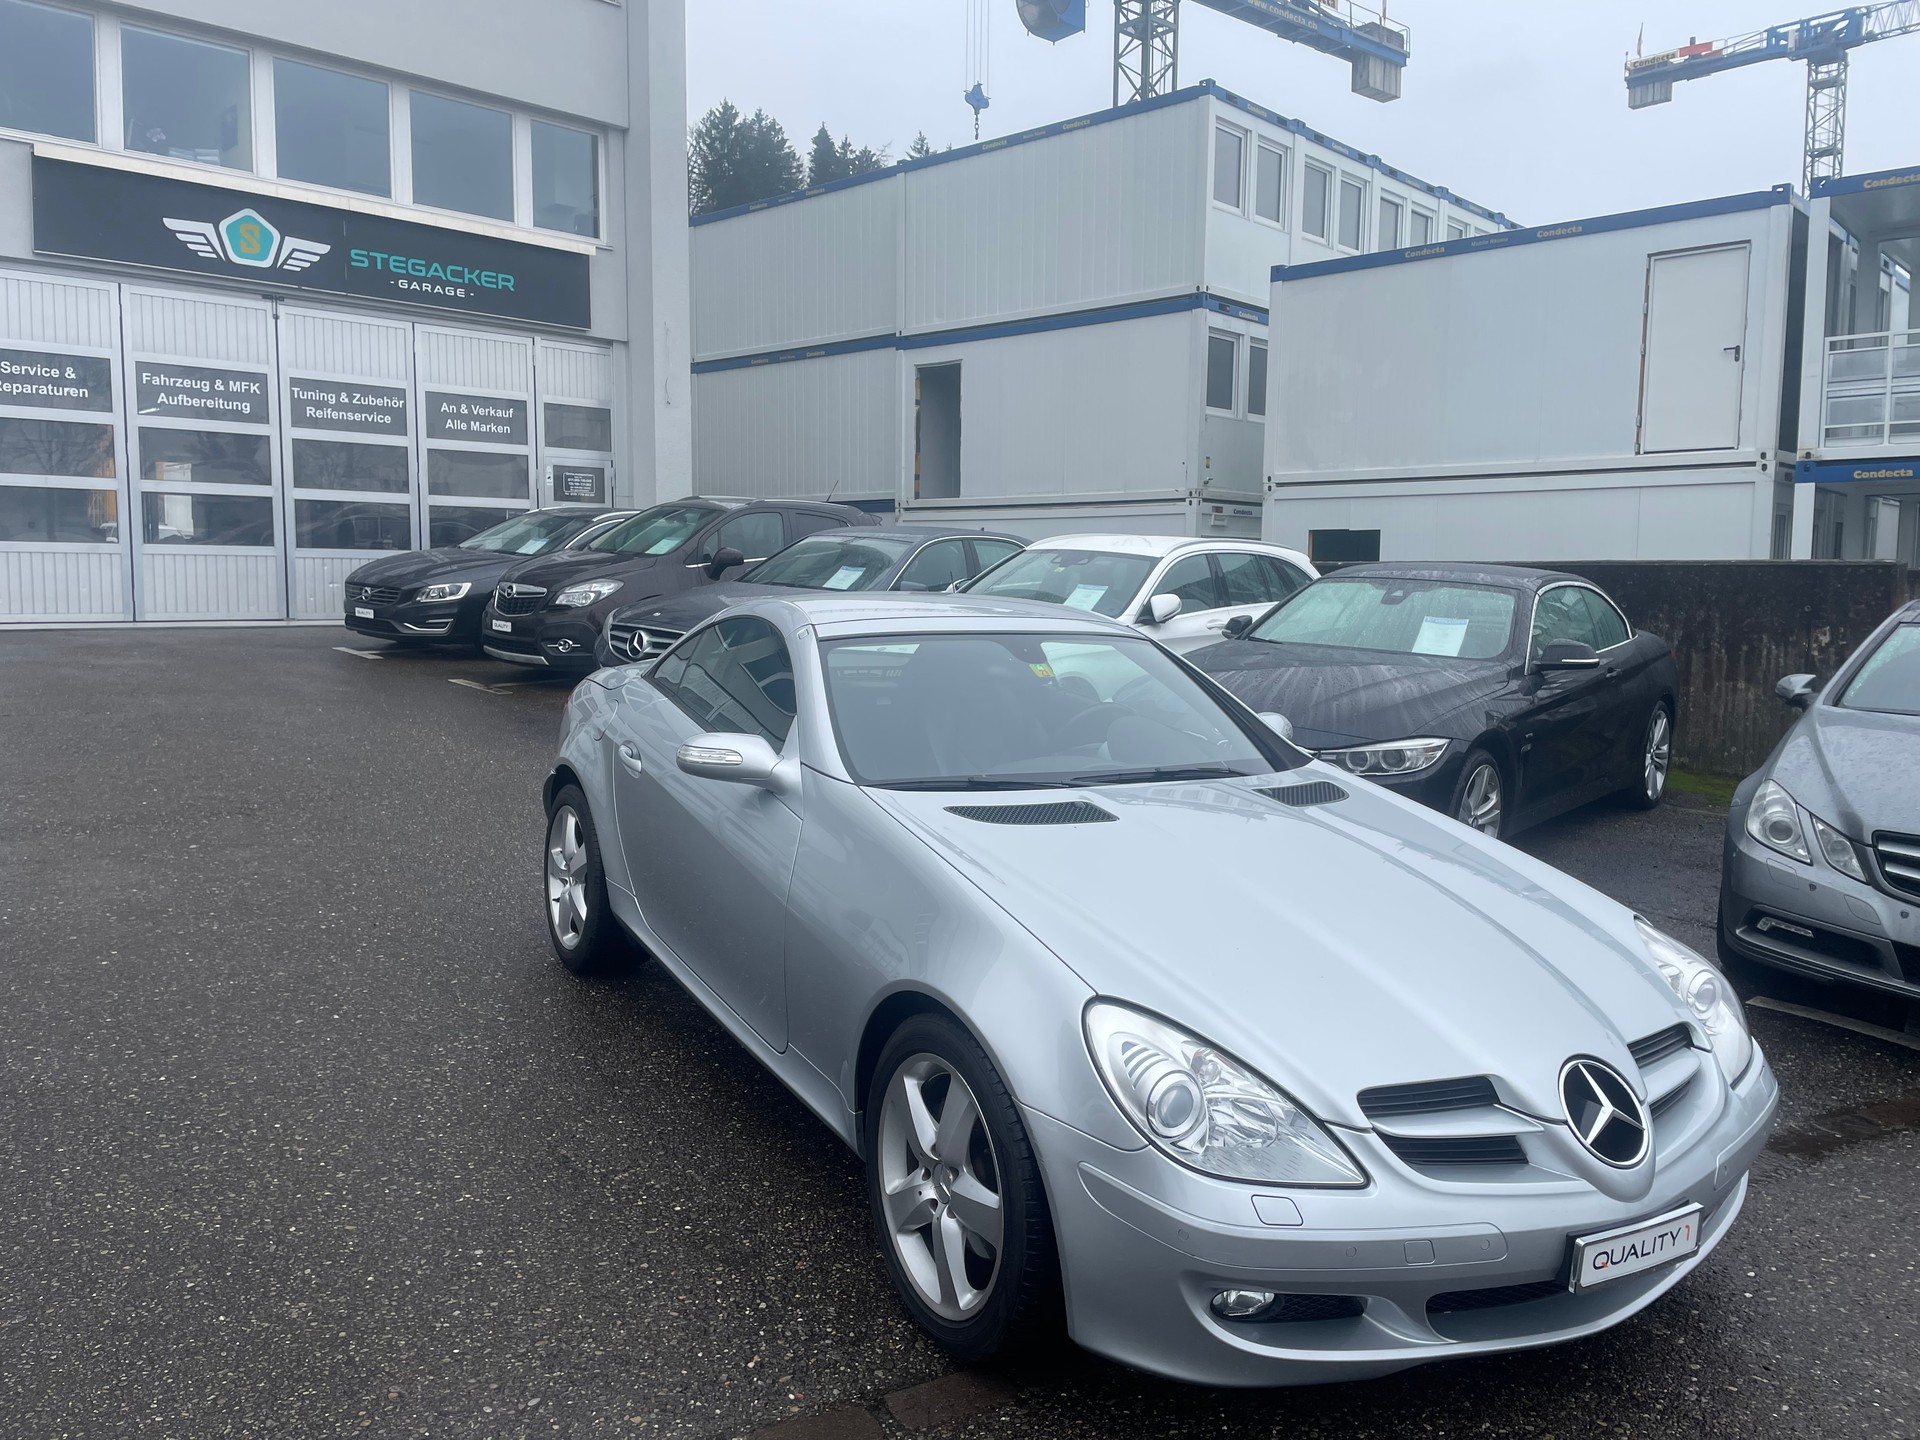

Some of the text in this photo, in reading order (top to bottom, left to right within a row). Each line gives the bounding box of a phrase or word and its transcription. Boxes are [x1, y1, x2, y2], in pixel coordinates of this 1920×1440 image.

[1633, 52, 1676, 68] Condecta
[1405, 246, 1445, 258] Condecta
[1537, 225, 1583, 238] Condecta
[350, 249, 515, 292] STEGACKER
[1, 361, 76, 379] Service &
[0, 380, 89, 398] eparaturen
[142, 373, 261, 394] Fahrzeug & MFK
[157, 392, 251, 414] Aufbereitung
[291, 387, 404, 409] Tuning & Zubehör
[306, 406, 391, 424] Reifenservice
[440, 402, 514, 418] An & Verkauf
[445, 419, 511, 434] Alle Marken
[1853, 469, 1913, 479] Condecta
[1593, 1227, 1681, 1270] QUALITY
